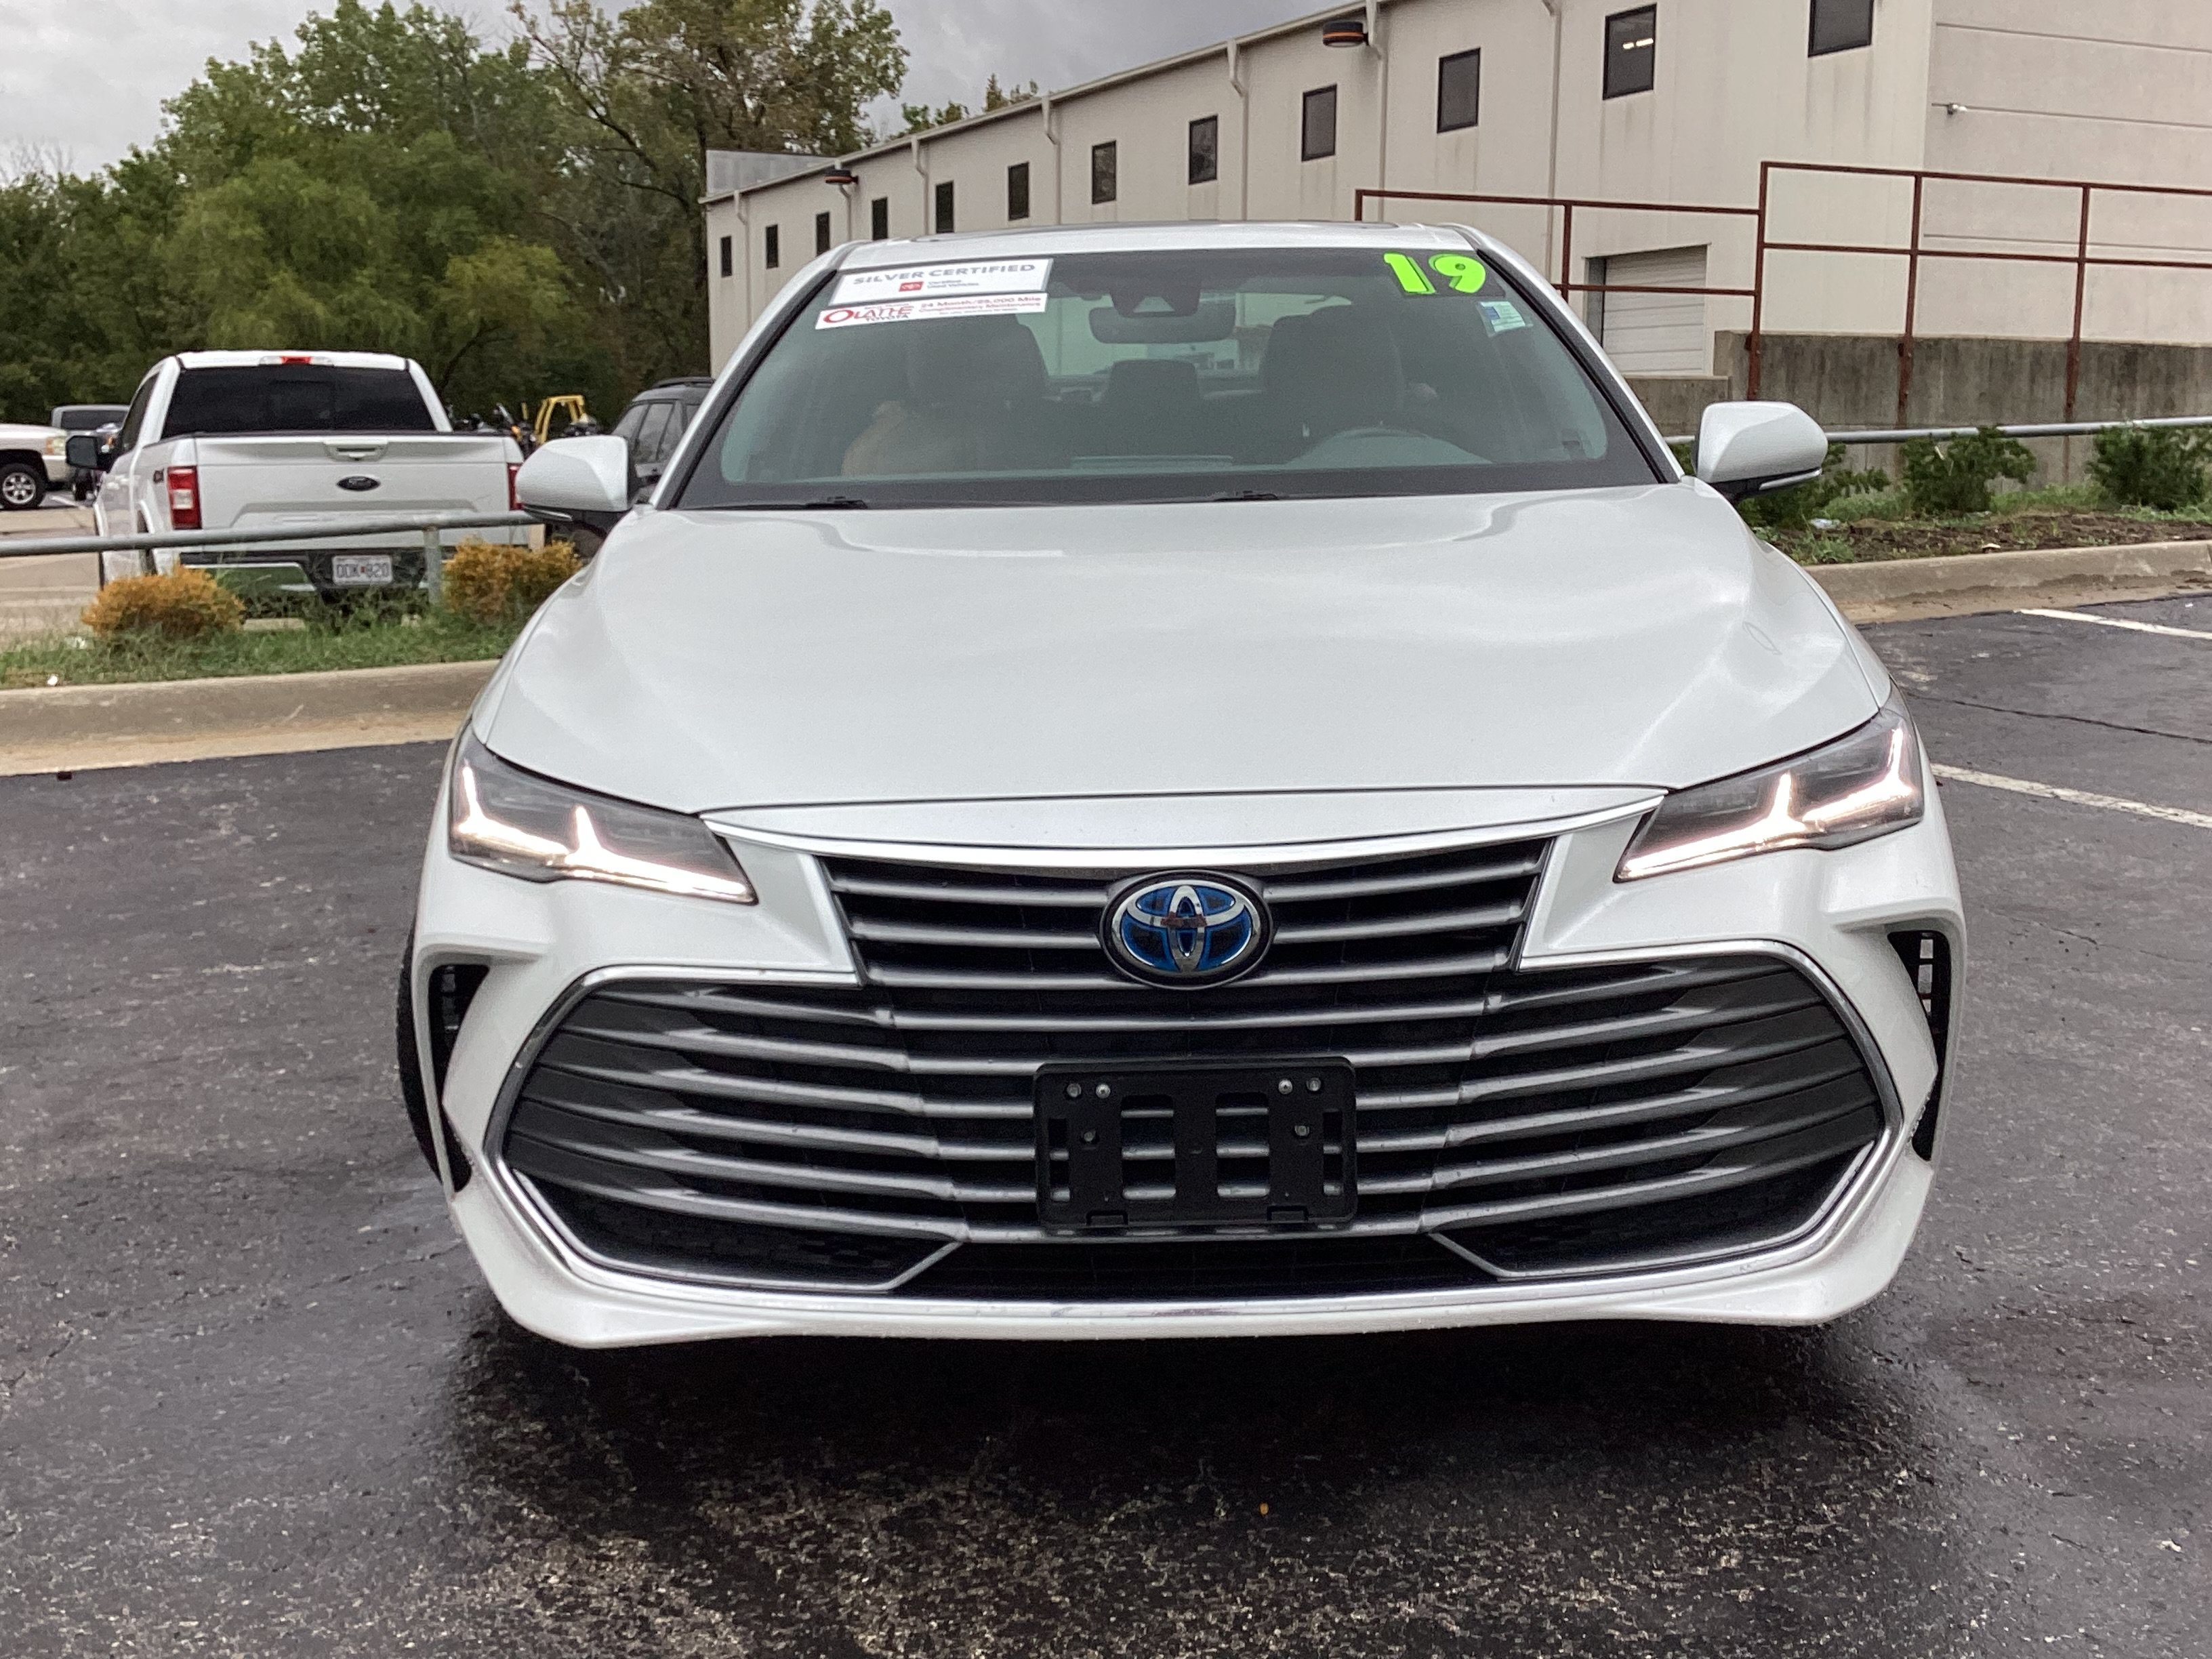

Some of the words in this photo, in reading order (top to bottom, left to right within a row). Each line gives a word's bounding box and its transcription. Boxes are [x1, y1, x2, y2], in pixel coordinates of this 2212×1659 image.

[853, 271, 924, 285] SILVER
[928, 264, 1036, 277] CERTIFIED
[1383, 251, 1486, 294] 19
